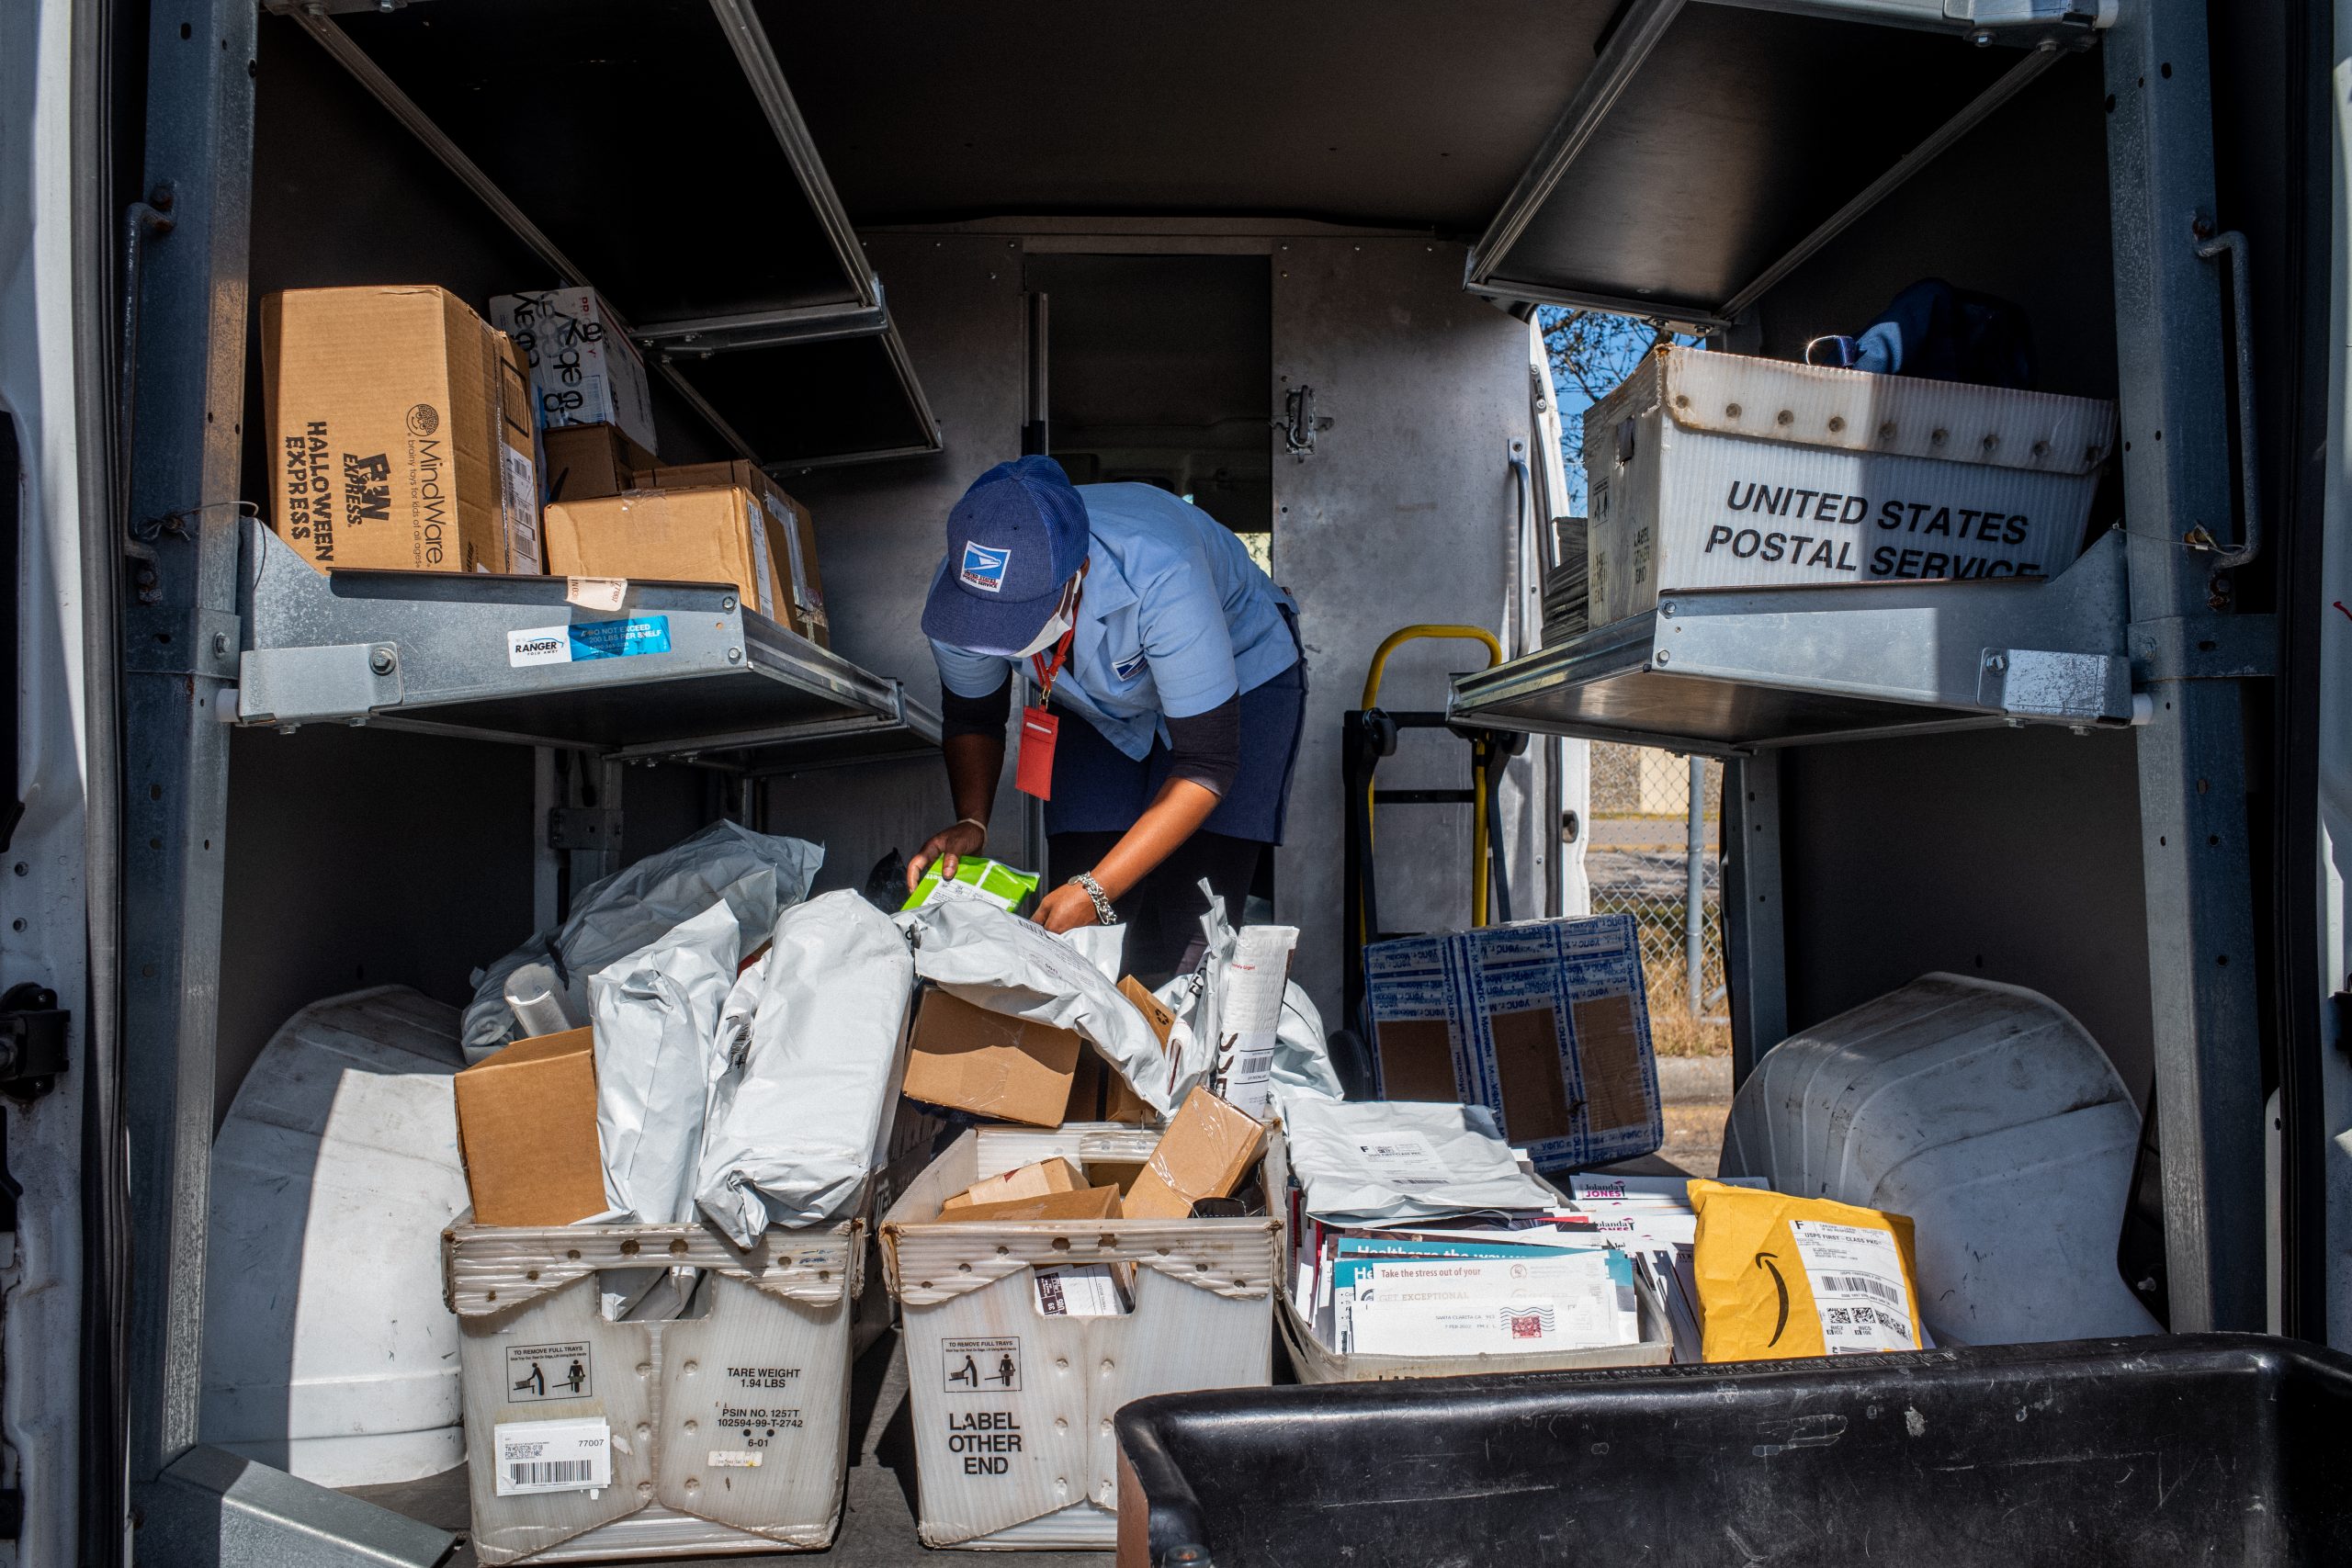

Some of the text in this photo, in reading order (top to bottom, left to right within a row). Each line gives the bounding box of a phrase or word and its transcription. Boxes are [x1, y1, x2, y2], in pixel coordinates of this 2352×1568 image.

[285, 435, 311, 539] EXPRESS
[343, 453, 363, 525] EXPRESS
[407, 439, 416, 467] brainy
[413, 519, 421, 528] of
[307, 421, 334, 561] HALLOWEEN
[419, 439, 446, 564] MindWare
[1727, 481, 2030, 546] UNITED STATES
[1705, 525, 1858, 571] POSTAL
[619, 632, 636, 641] PER
[637, 629, 662, 638] SHELF
[620, 624, 650, 634] EXCEED
[514, 641, 557, 653] RANGER
[1542, 1139, 1565, 1150] УФПС
[1585, 1183, 1619, 1191] Jolanda
[1586, 1190, 1622, 1198] JONES
[1794, 1220, 1804, 1230] F
[1381, 1267, 1481, 1279] Take the stress out of your
[1378, 1292, 1469, 1303] GET EXCEPTIONAL
[727, 1367, 801, 1379] TARE WEIGHT
[741, 1379, 786, 1388] 1.94 LBS
[722, 1408, 800, 1418] PSIN NO. 1257T
[717, 1418, 804, 1428] 102594-99-T-2742
[948, 1412, 1021, 1430] LABEL
[578, 1438, 605, 1448] 77007
[748, 1438, 769, 1448] 6-01
[948, 1434, 1022, 1452] OTHER
[964, 1456, 1009, 1475] END
